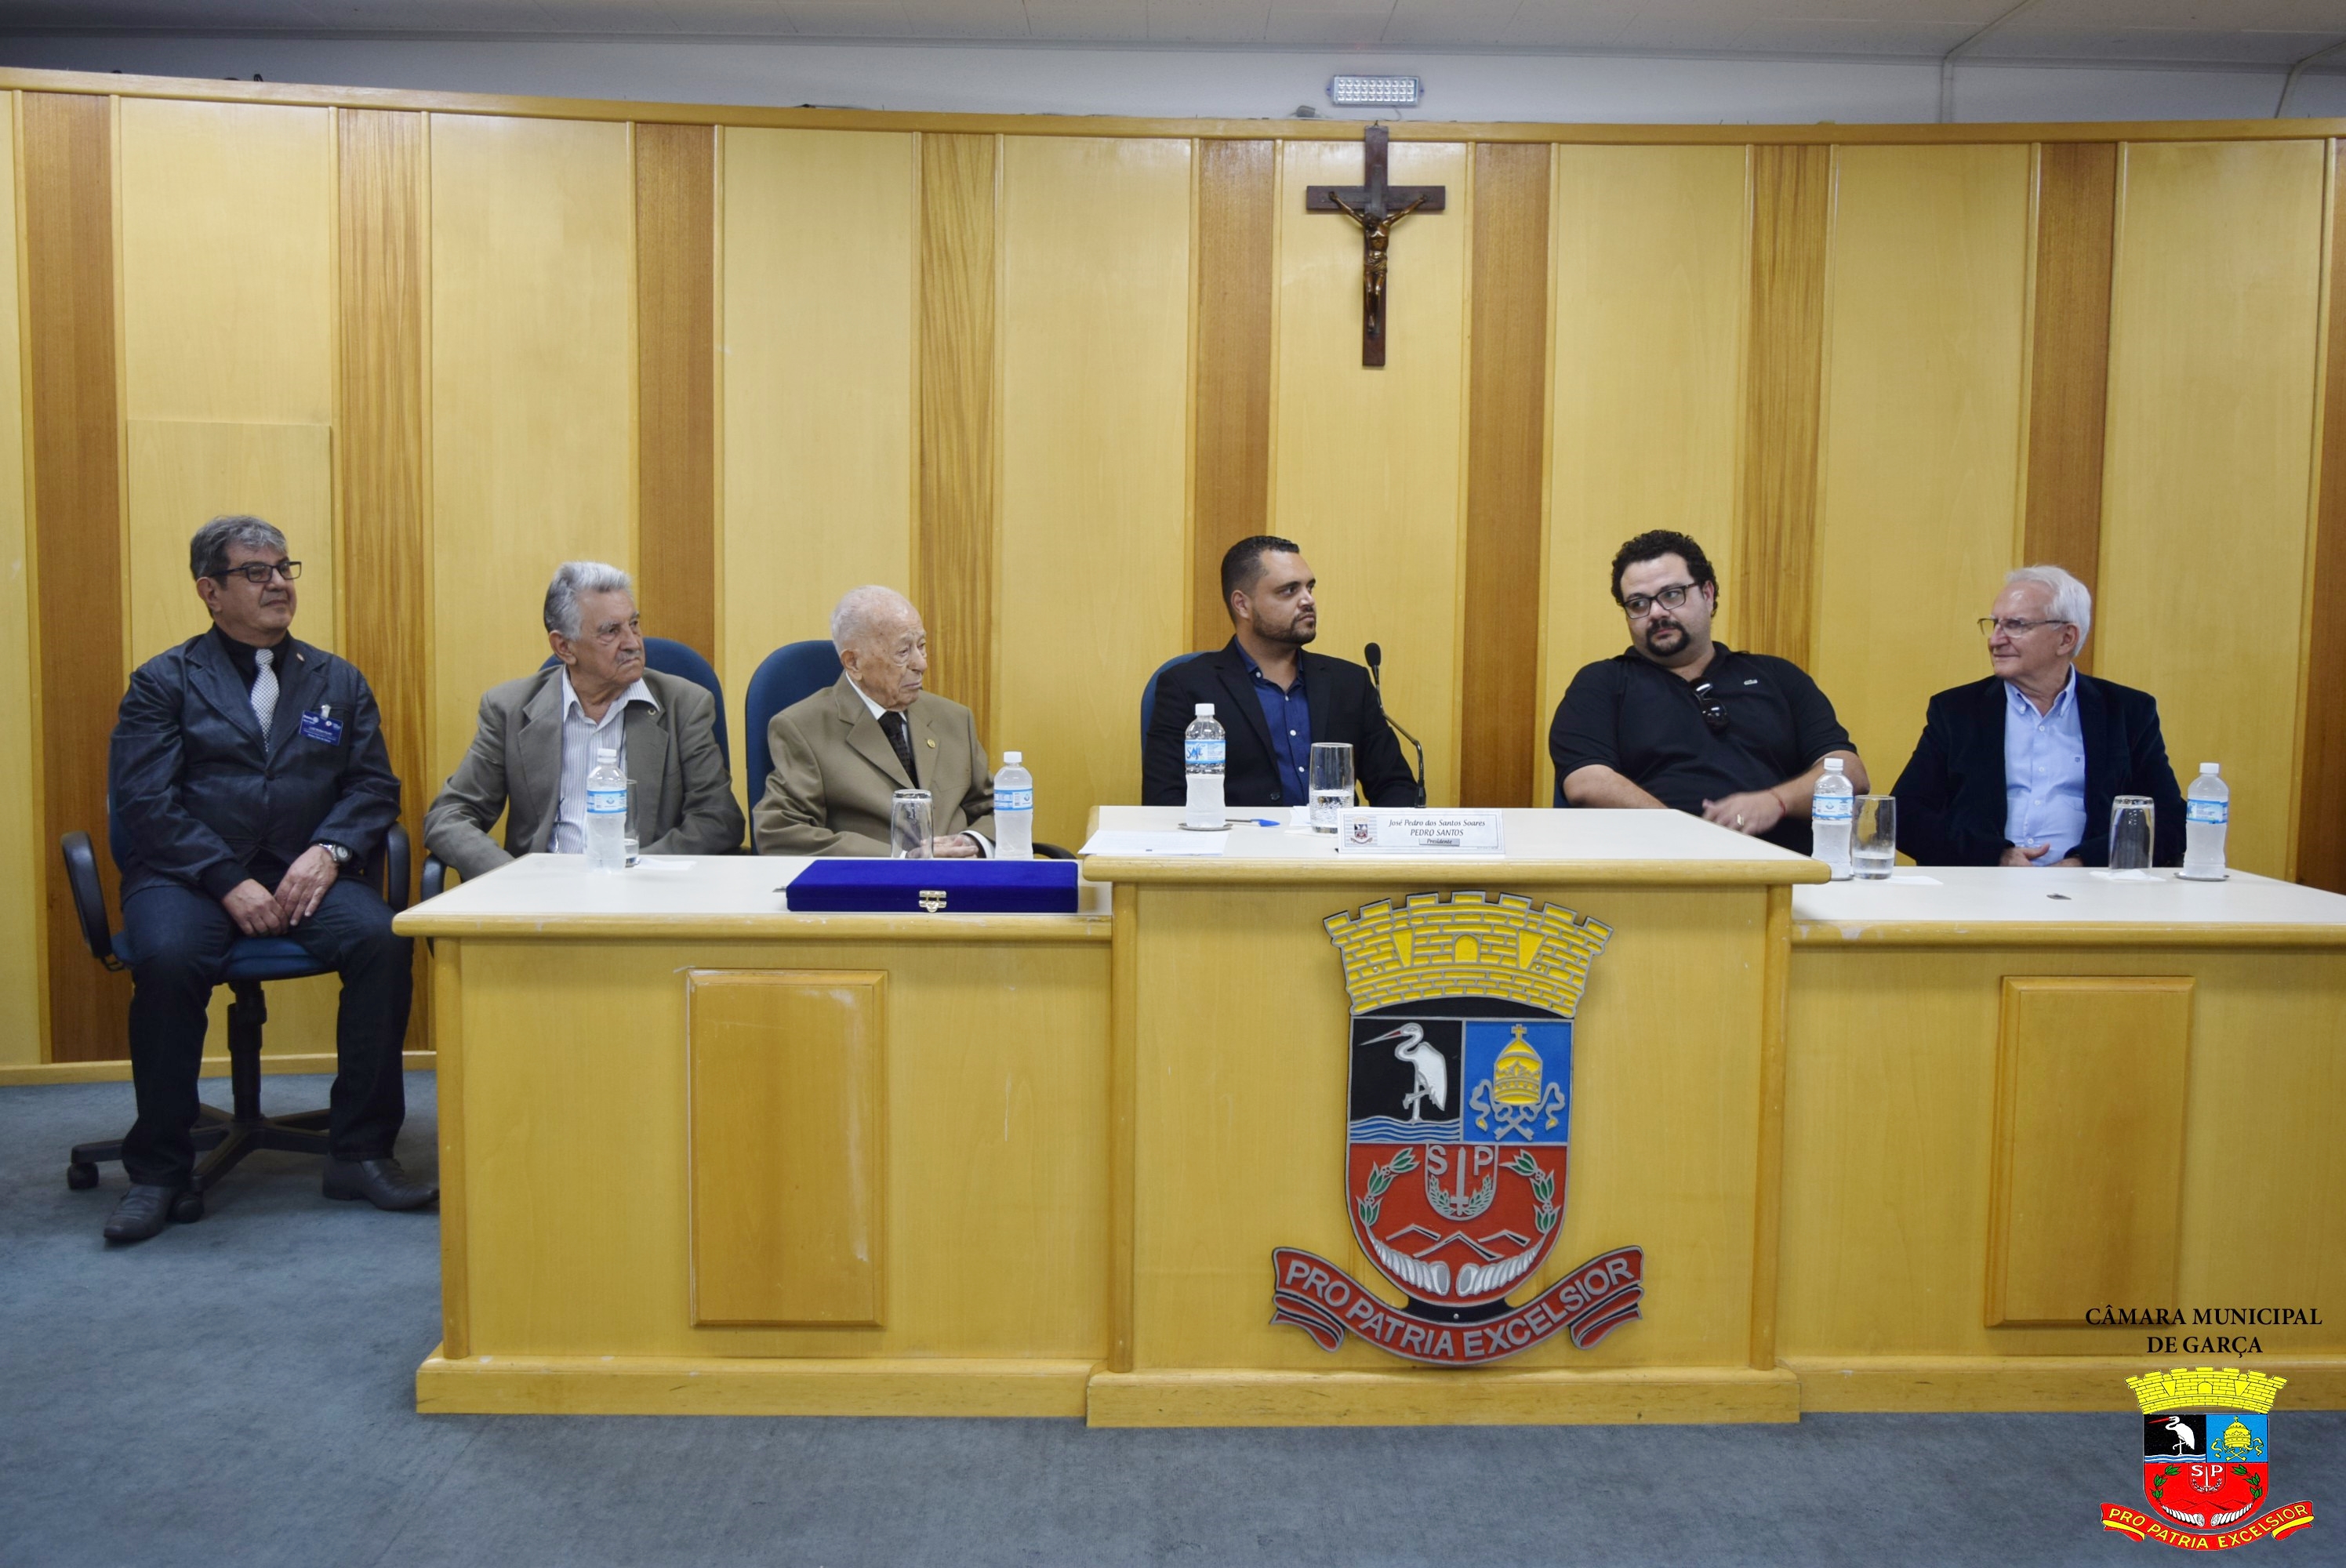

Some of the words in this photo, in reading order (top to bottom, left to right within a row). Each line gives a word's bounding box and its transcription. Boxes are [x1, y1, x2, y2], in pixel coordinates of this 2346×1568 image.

[1388, 818, 1403, 828] José
[1284, 1259, 1350, 1308] PRO
[1346, 1300, 1454, 1357] PATRIA
[1463, 1258, 1635, 1357] EXCELSIOR
